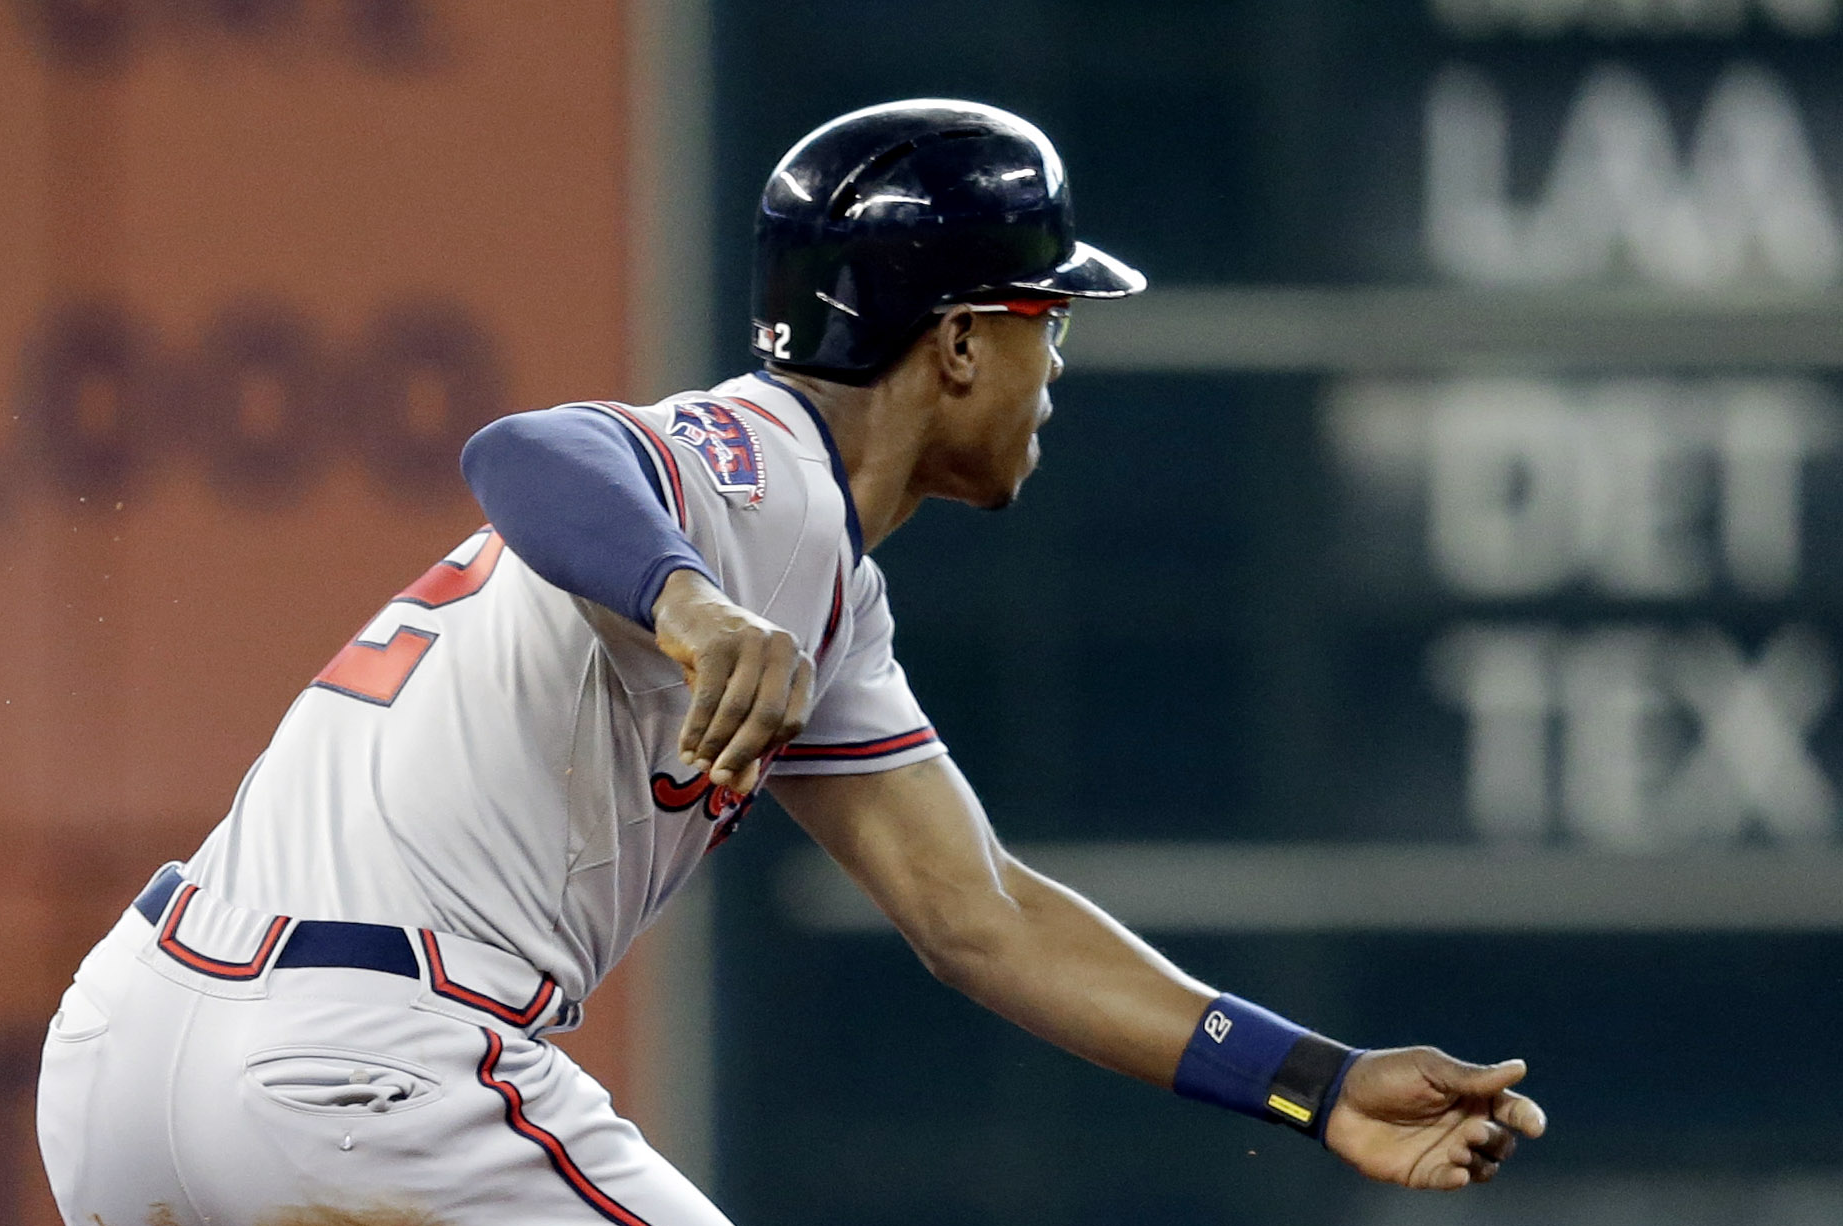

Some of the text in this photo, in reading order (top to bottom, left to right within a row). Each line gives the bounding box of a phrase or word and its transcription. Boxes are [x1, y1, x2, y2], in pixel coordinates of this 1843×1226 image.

[1425, 60, 1841, 285] LAA
[774, 322, 791, 360] 2
[1425, 378, 1841, 598] DET
[1427, 624, 1841, 852] TEX
[1204, 1010, 1233, 1044] 2
